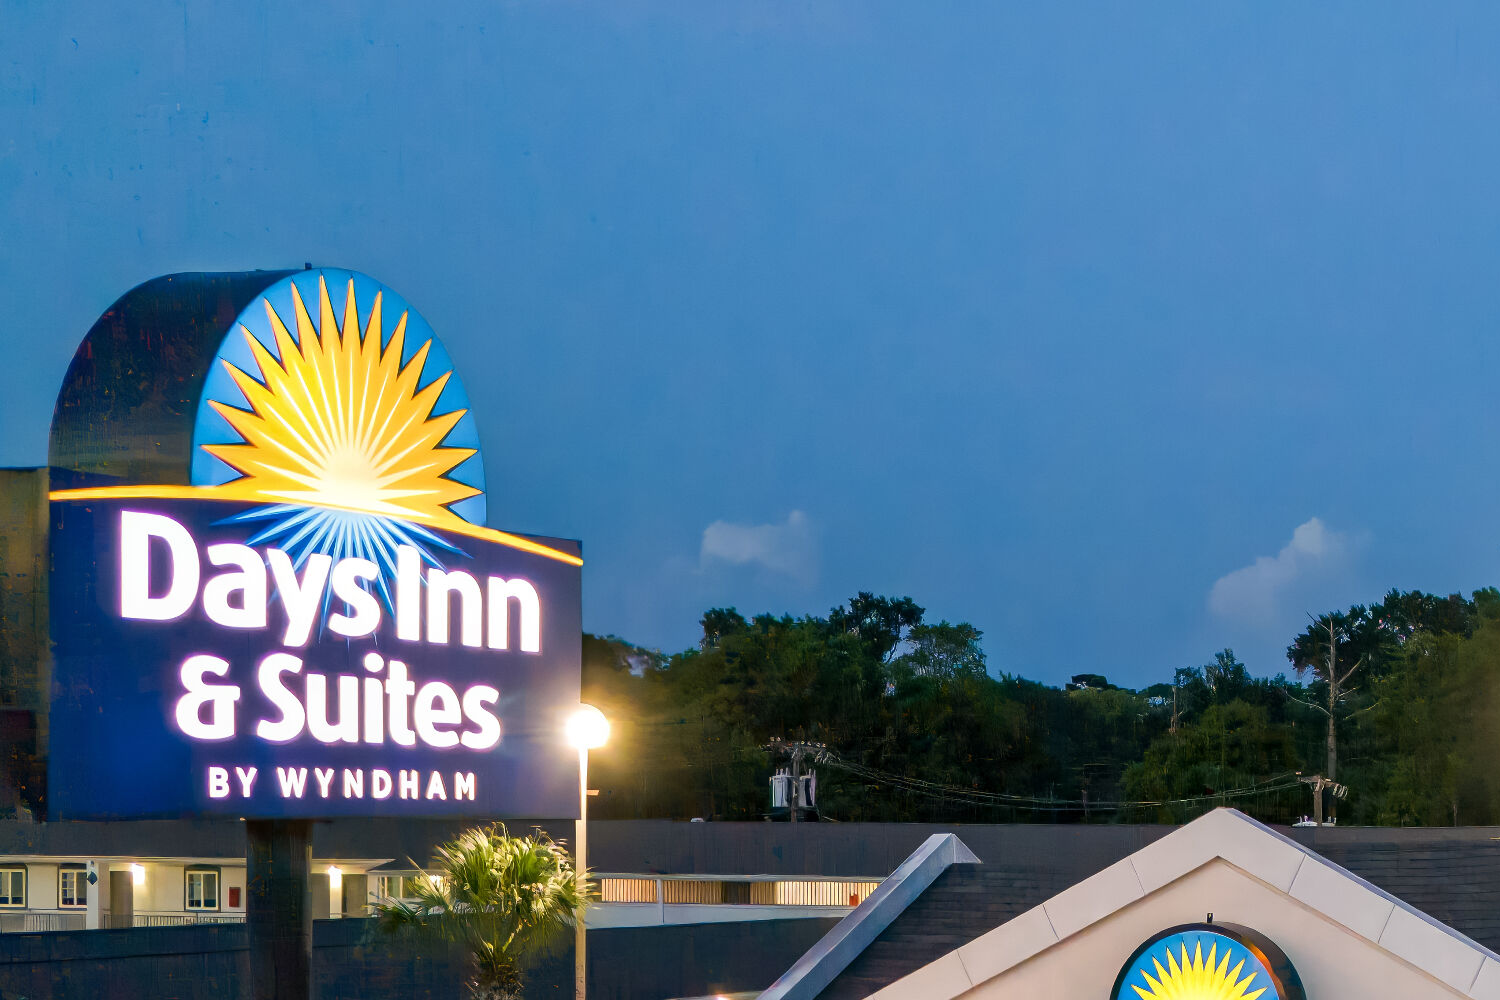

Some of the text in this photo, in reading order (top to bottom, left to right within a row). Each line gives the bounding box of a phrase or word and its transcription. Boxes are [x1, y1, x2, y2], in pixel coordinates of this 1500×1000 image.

[119, 509, 542, 654] Days Inn
[174, 652, 501, 750] & Suites
[207, 766, 477, 801] BY WYNDHAM
